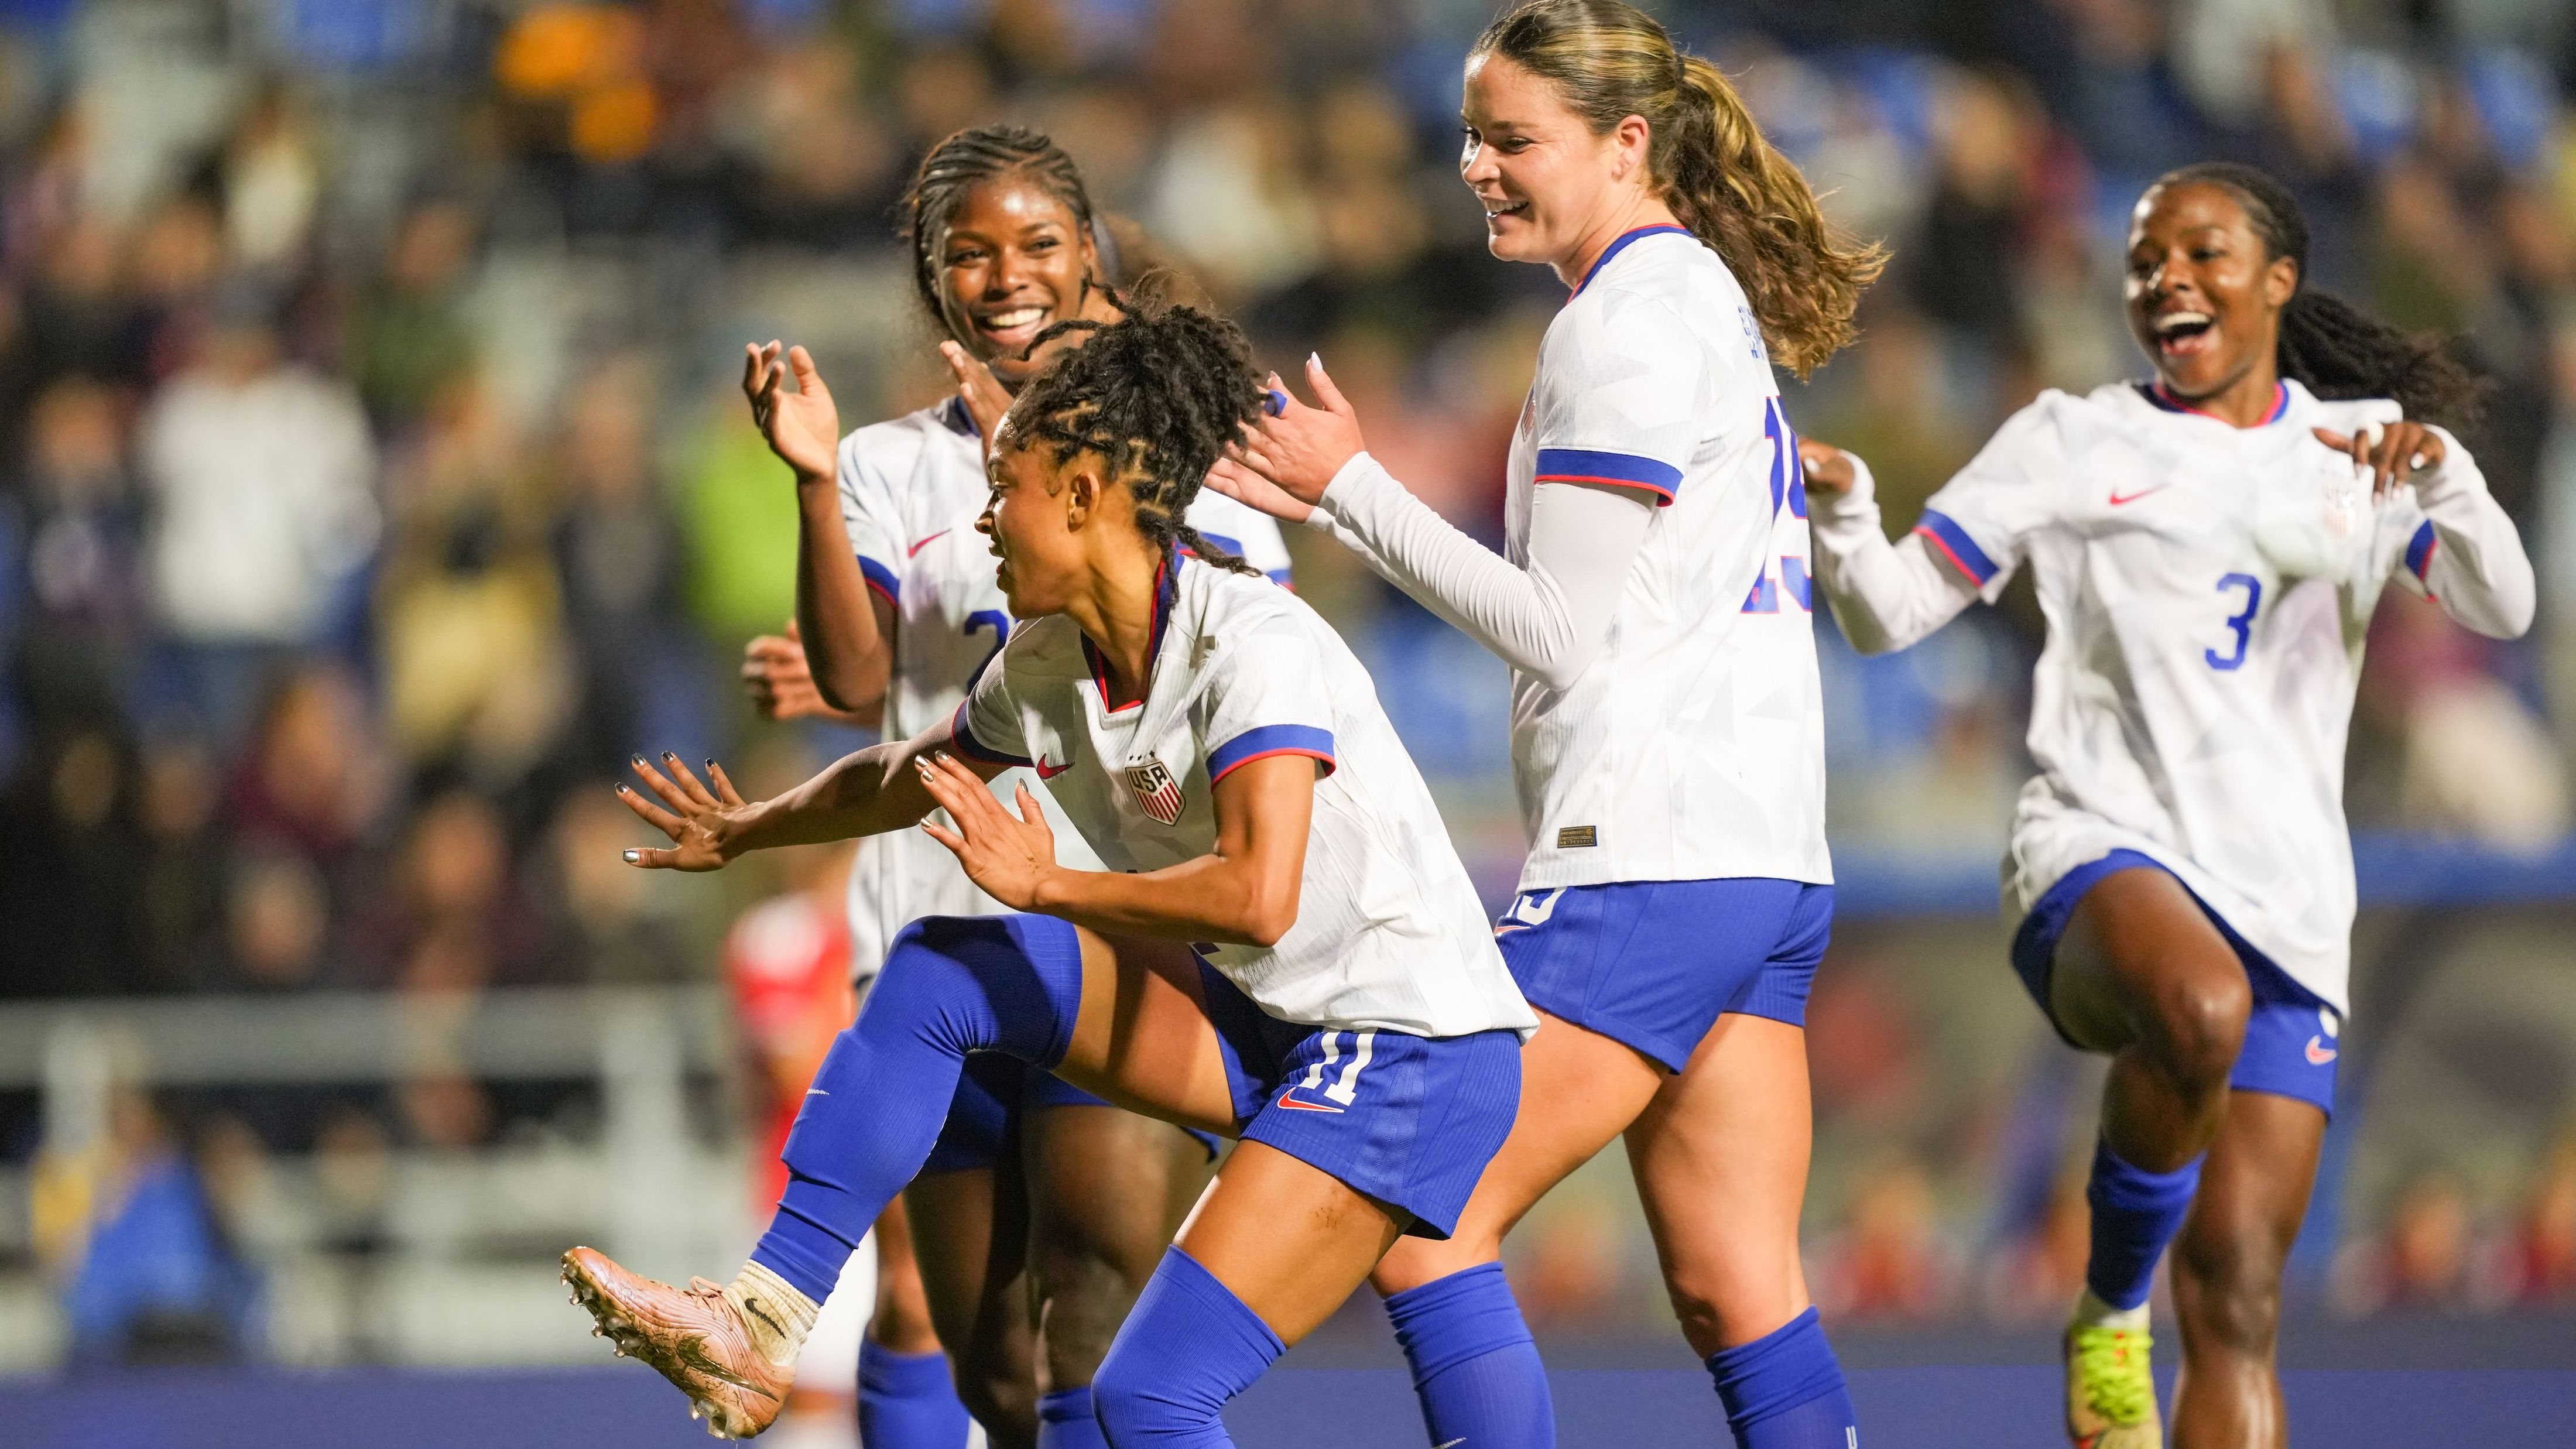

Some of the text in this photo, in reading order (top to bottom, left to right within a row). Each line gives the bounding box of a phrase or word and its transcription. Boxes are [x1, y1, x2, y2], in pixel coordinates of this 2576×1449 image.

[964, 609, 1023, 696] 2
[2205, 572, 2261, 671] 3
[1128, 765, 1167, 793] USA
[1298, 1026, 1378, 1107] 11
